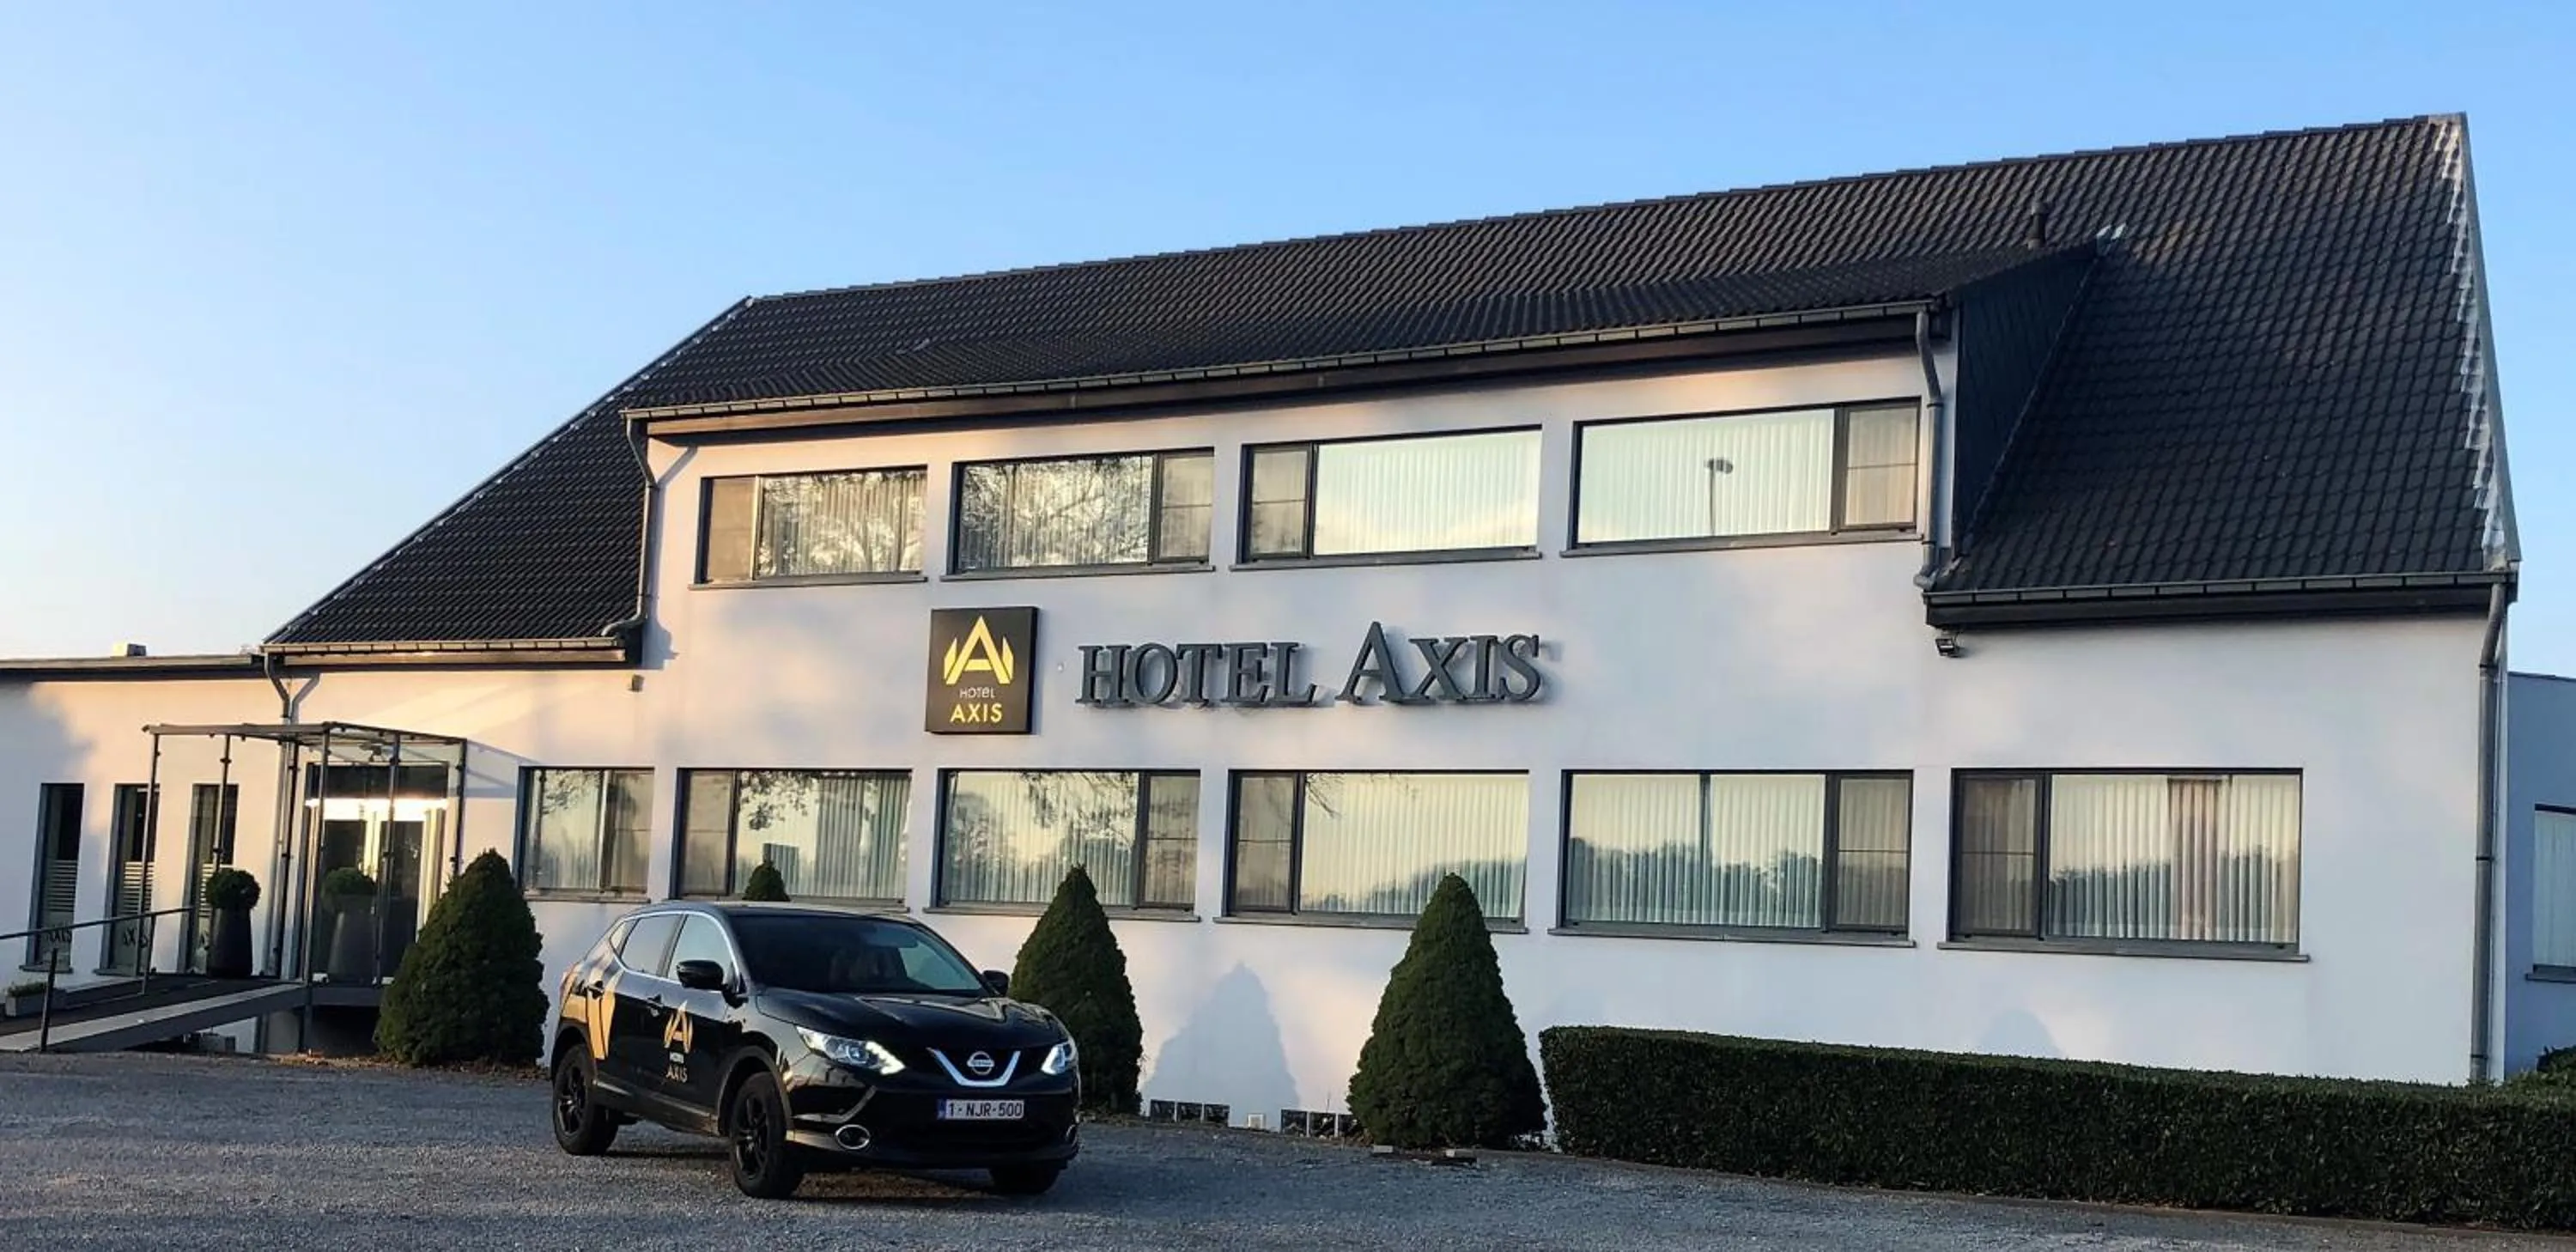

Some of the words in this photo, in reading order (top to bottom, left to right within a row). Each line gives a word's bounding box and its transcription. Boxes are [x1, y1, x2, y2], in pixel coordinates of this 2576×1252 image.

[1075, 641, 1317, 707] HOTEL
[1336, 621, 1544, 703] AXIS
[950, 702, 1003, 723] AXIS
